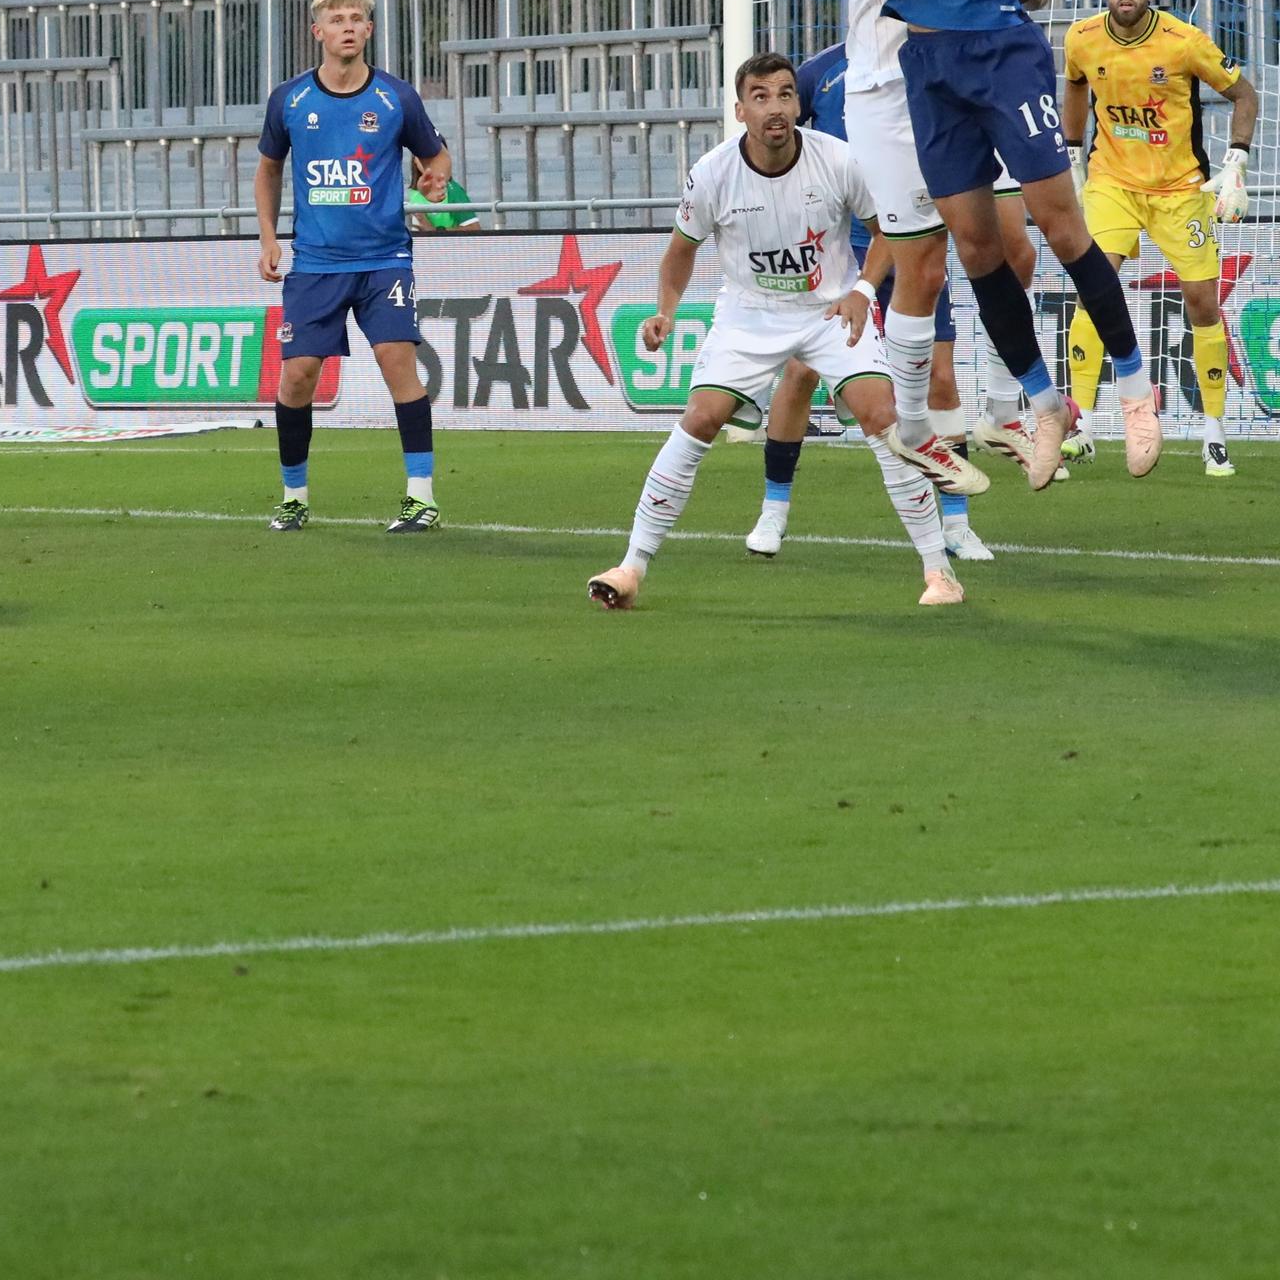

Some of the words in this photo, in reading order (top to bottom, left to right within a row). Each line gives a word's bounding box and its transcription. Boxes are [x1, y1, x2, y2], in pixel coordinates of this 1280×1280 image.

[1018, 94, 1060, 138] 18
[1105, 105, 1162, 129] STAR
[1151, 133, 1166, 143] TV
[306, 159, 366, 186] STAR
[311, 190, 347, 202] SPORT
[353, 190, 368, 201] TV
[1186, 215, 1219, 249] 34
[749, 244, 818, 275] STAR
[758, 276, 807, 291] SPORT
[89, 320, 261, 391] SPORT
